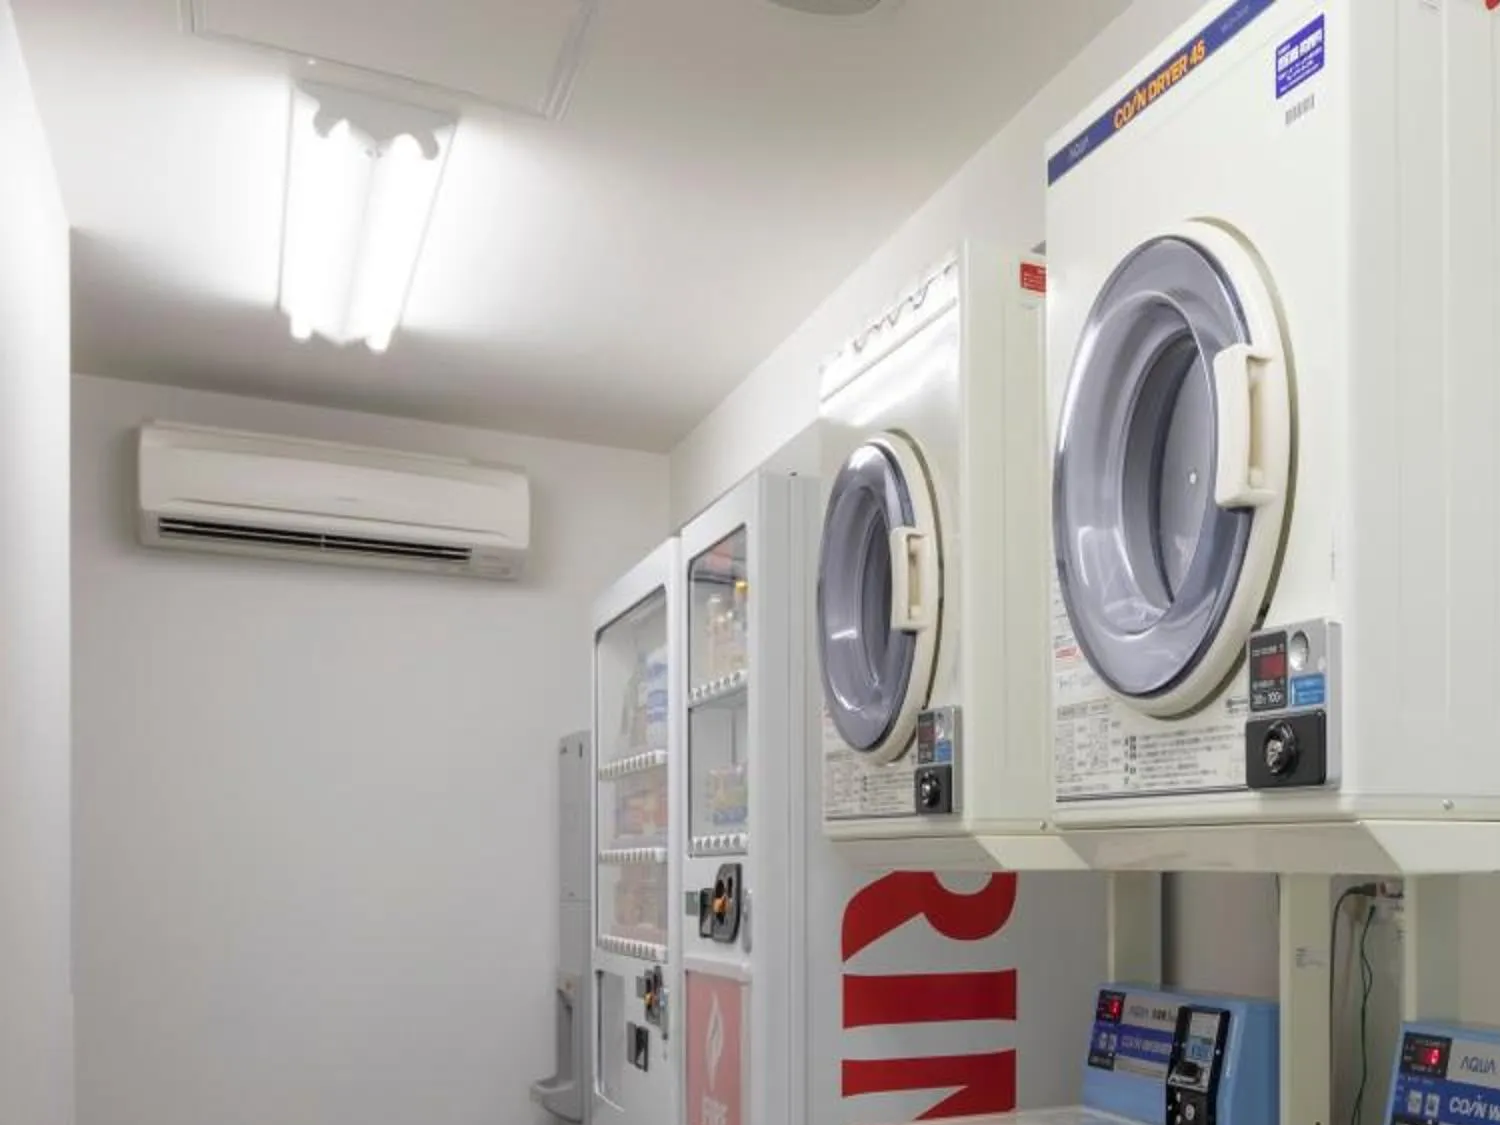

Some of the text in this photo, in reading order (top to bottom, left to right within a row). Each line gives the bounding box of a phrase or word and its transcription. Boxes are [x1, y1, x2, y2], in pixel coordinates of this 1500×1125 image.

[1149, 58, 1188, 99] DRYER
[1190, 39, 1206, 65] 45
[1460, 1055, 1496, 1074] AQUA
